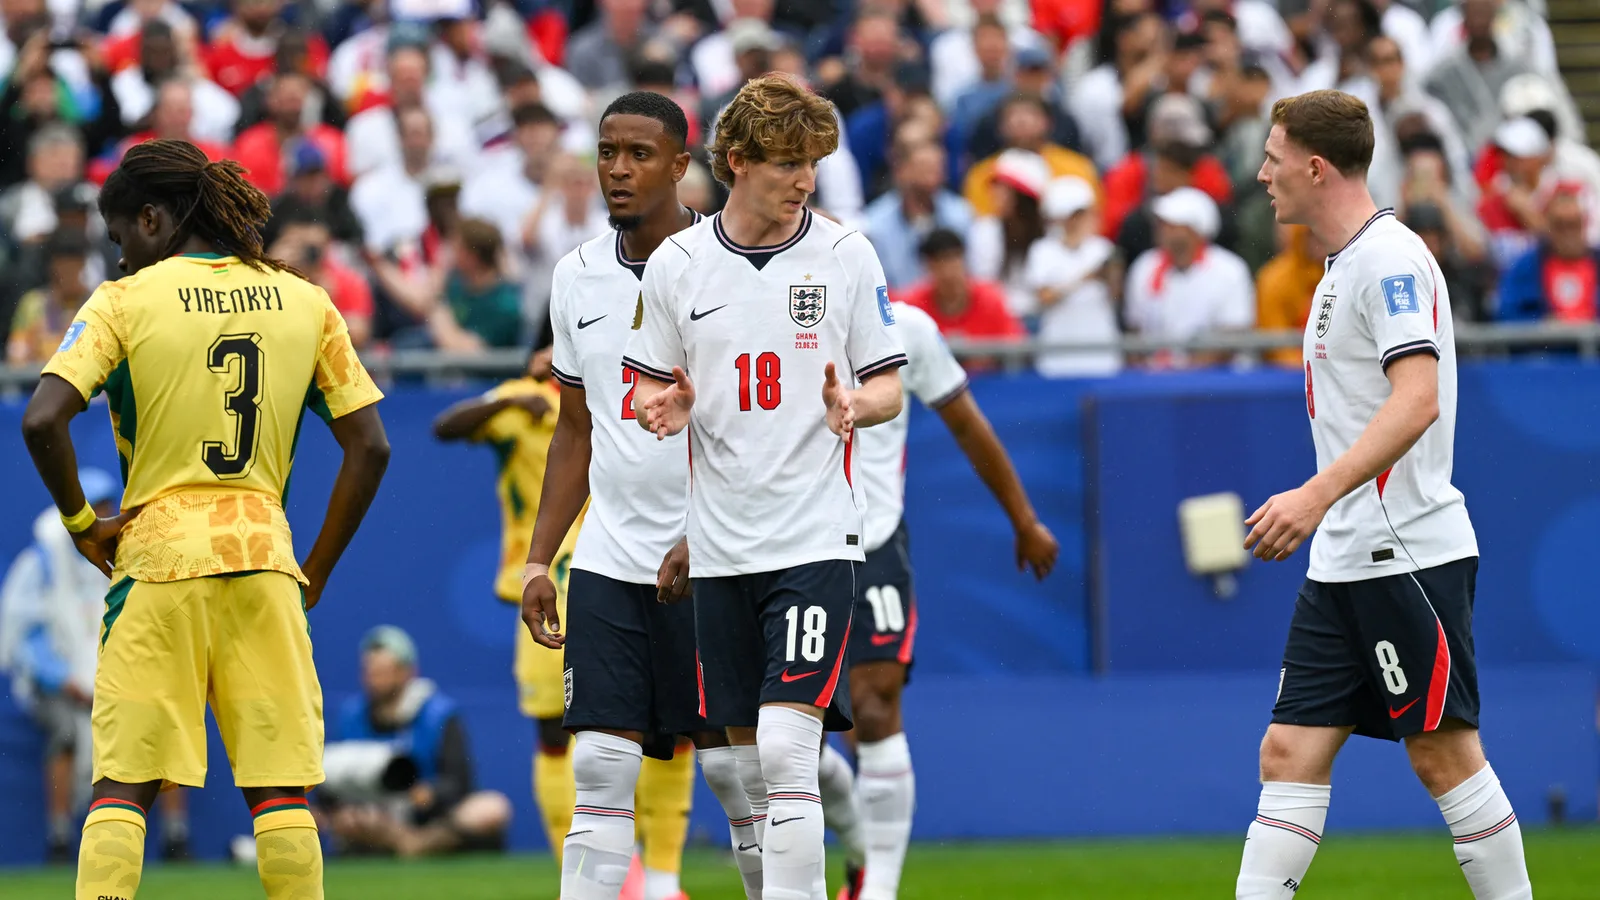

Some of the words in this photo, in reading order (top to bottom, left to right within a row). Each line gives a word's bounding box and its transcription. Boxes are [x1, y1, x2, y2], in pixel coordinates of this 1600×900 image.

[178, 286, 283, 314] YIRENKYI
[795, 341, 818, 349] 23.06.26
[202, 332, 264, 480] 3
[735, 352, 782, 411] 18
[785, 605, 827, 662] 18
[865, 585, 905, 632] 10
[1375, 640, 1408, 695] 8
